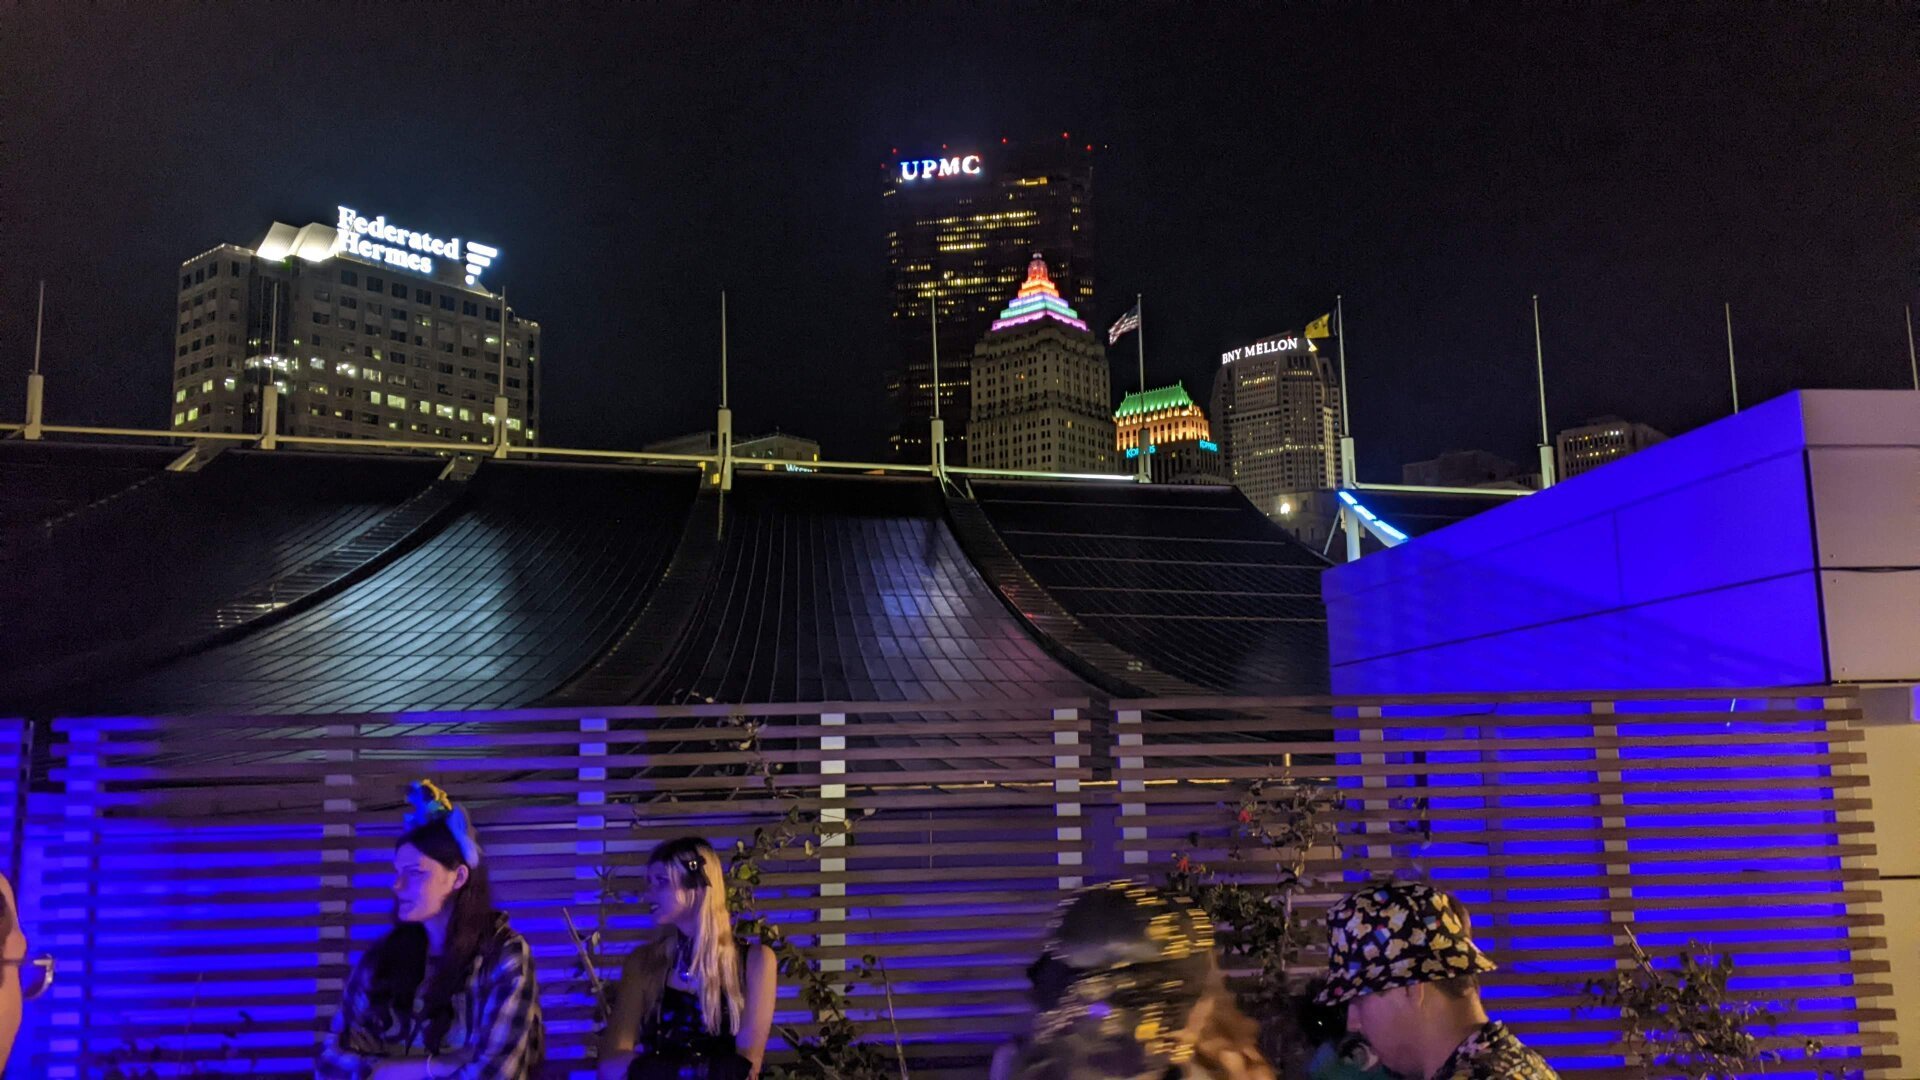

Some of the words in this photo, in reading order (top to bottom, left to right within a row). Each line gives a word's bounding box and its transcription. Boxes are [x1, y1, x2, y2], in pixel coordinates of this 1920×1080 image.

[900, 155, 980, 180] UPMC
[337, 205, 460, 260] Federated
[337, 228, 433, 274] Hermes
[1222, 348, 1242, 365] BNY
[1244, 338, 1298, 358] MELLON
